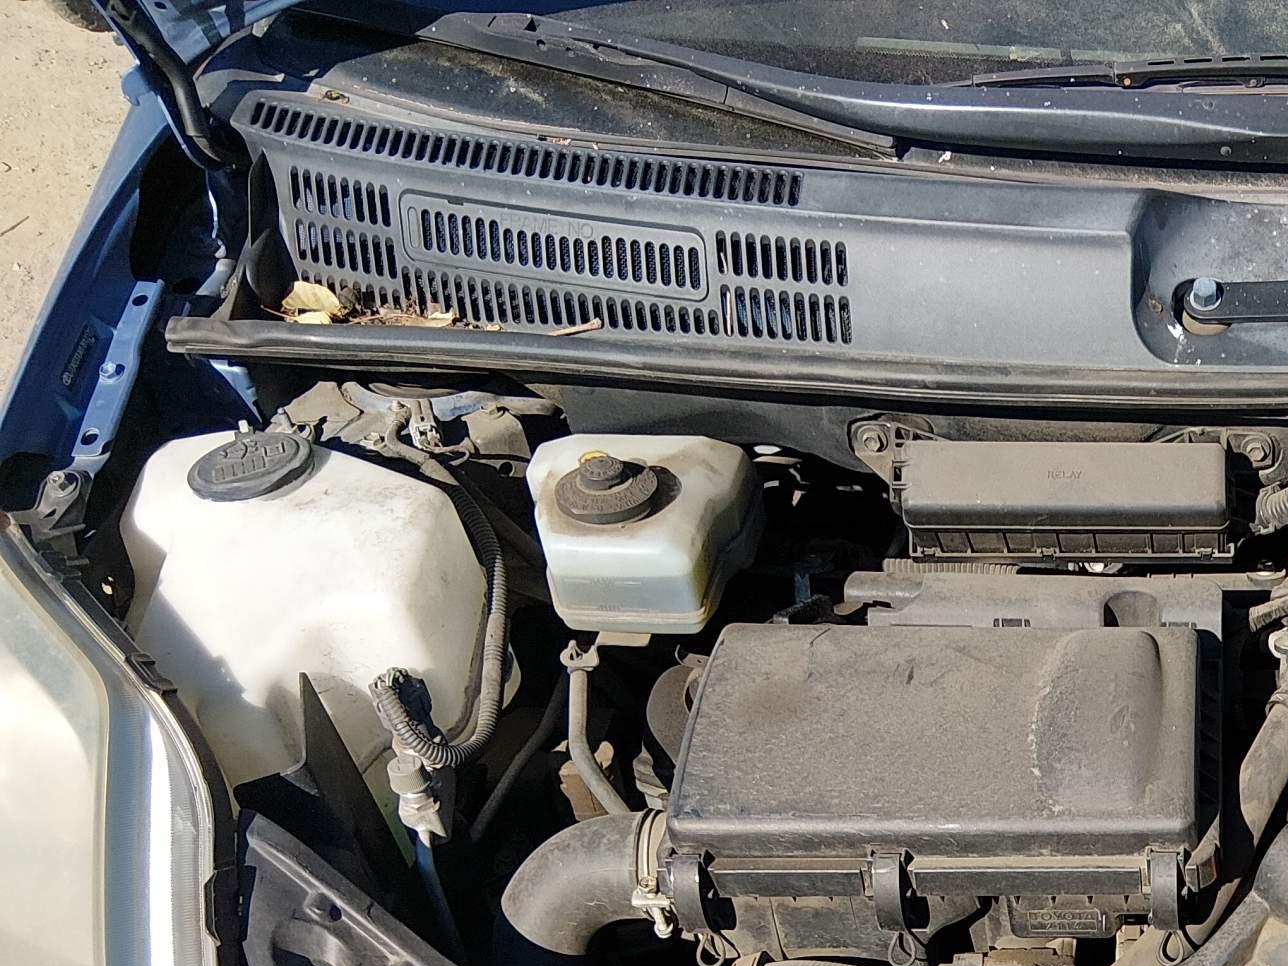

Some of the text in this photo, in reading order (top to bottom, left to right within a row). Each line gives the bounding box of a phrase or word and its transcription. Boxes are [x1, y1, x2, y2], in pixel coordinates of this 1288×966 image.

[568, 221, 594, 239] NO
[1047, 470, 1082, 480] RELAY
[1031, 911, 1095, 921] TOYOTA
